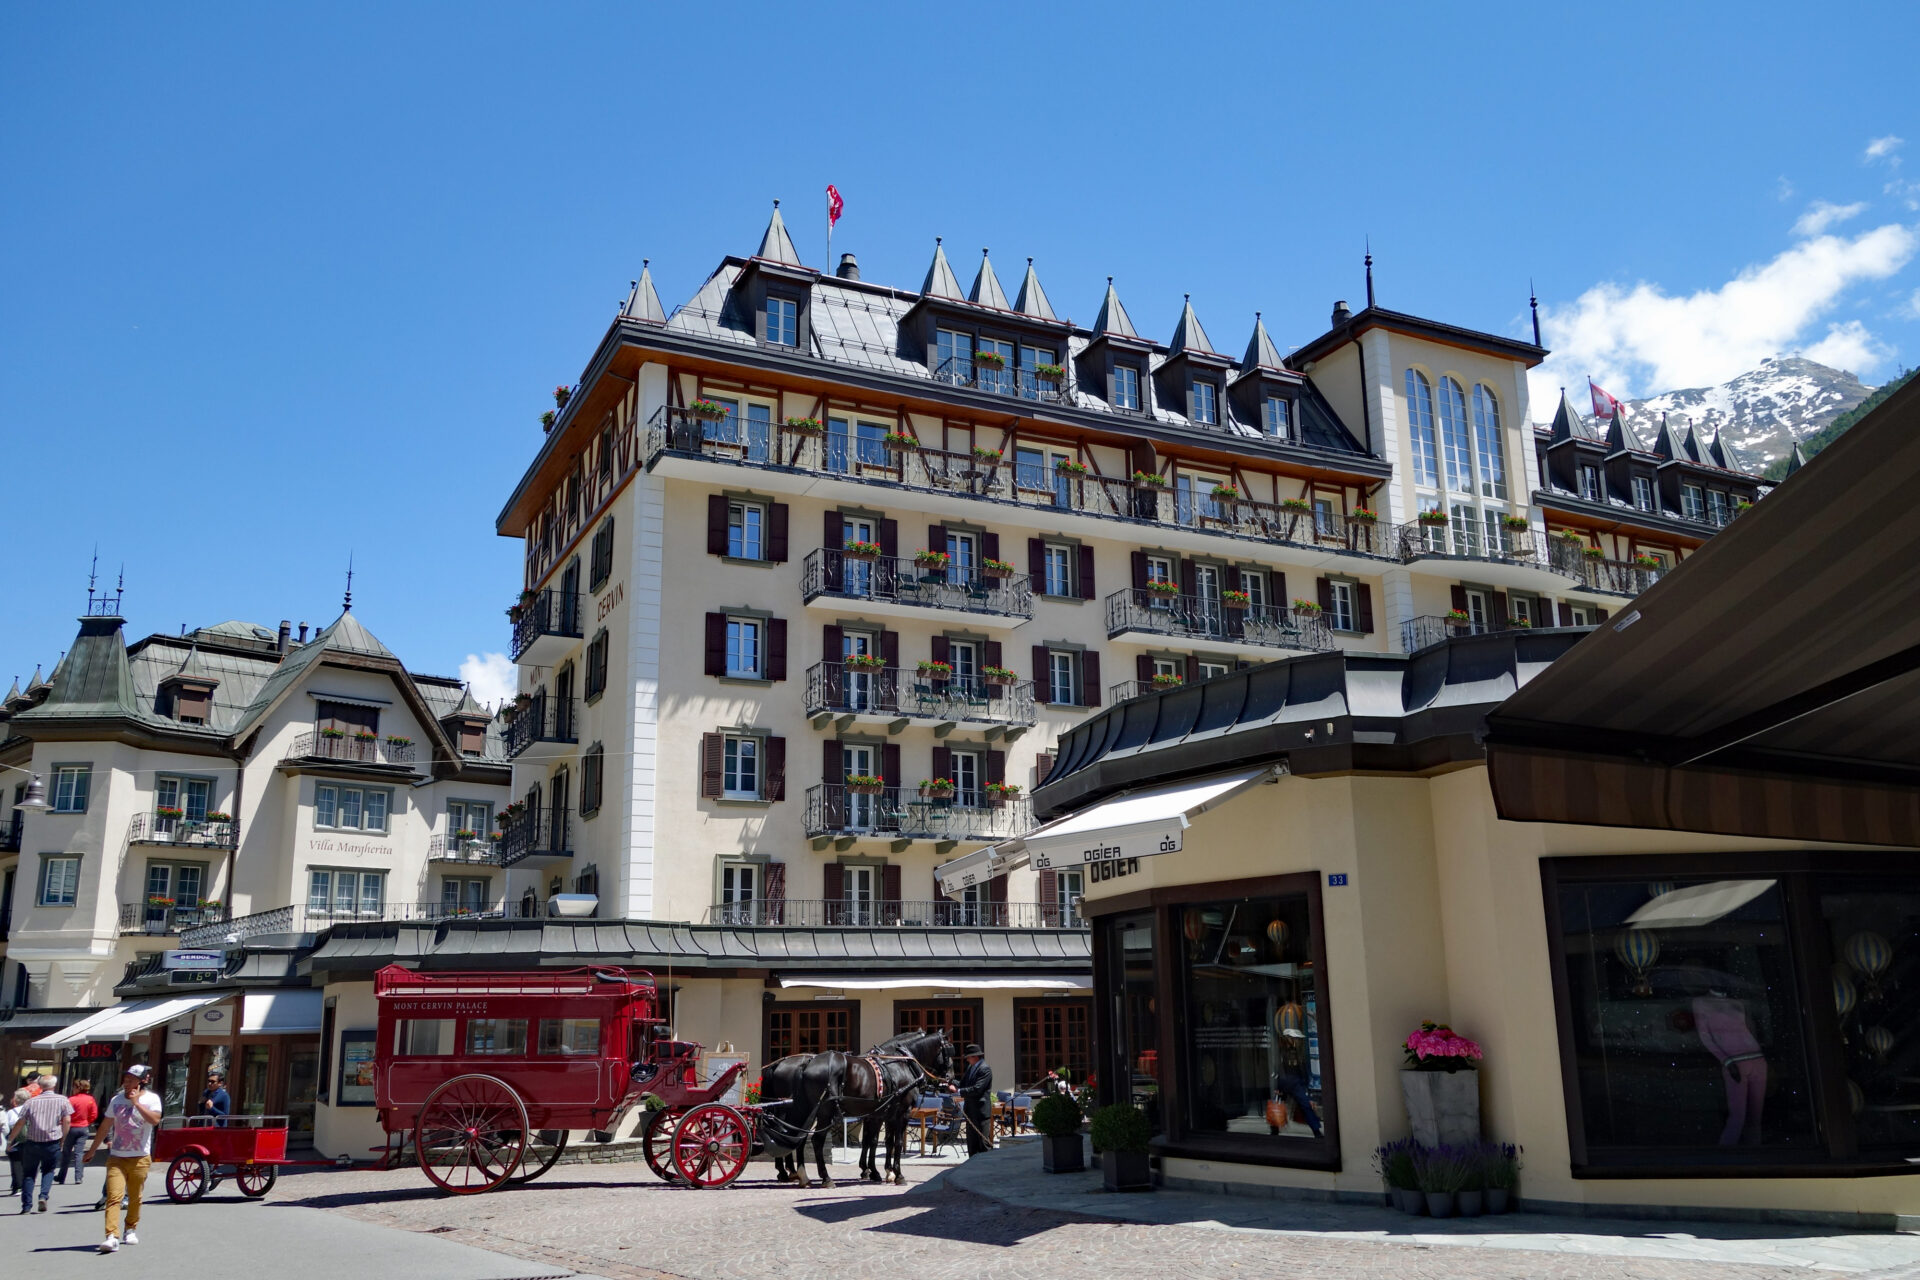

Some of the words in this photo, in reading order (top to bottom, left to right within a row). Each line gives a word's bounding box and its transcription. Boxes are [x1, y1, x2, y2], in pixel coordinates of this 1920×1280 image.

[597, 580, 624, 622] CERVIN
[309, 839, 333, 851] Villa
[337, 841, 393, 857] Margherita
[1160, 841, 1176, 851] OG
[1036, 858, 1051, 867] OG
[1332, 875, 1344, 885] 33
[393, 1002, 418, 1010] MONT
[421, 1002, 453, 1010] CERVIN
[455, 1001, 488, 1010] PALACE
[80, 1043, 112, 1058] UBS
